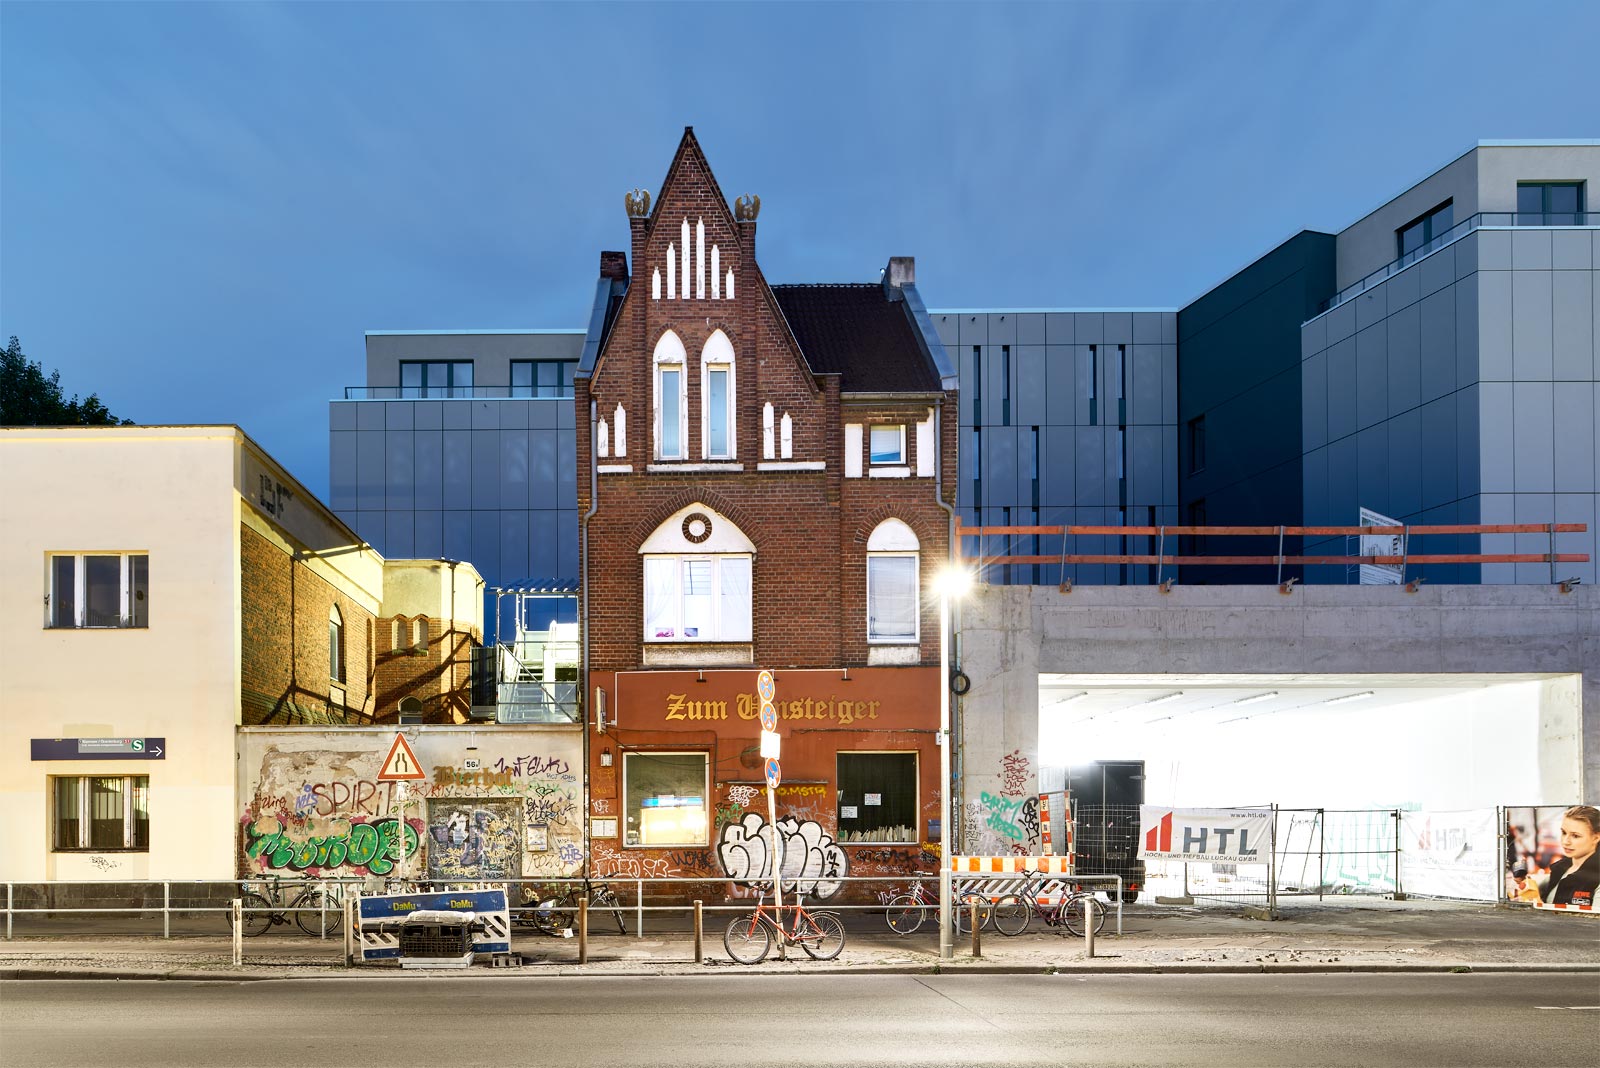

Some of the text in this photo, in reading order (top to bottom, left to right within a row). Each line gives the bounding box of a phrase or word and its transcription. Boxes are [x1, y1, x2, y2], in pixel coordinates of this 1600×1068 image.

[665, 693, 729, 721] Zum
[132, 739, 143, 751] S
[433, 765, 514, 791] Bierhof
[311, 779, 397, 817] SPIRIT
[1182, 826, 1258, 856] HTL
[392, 900, 474, 911] DaMu DaMu
